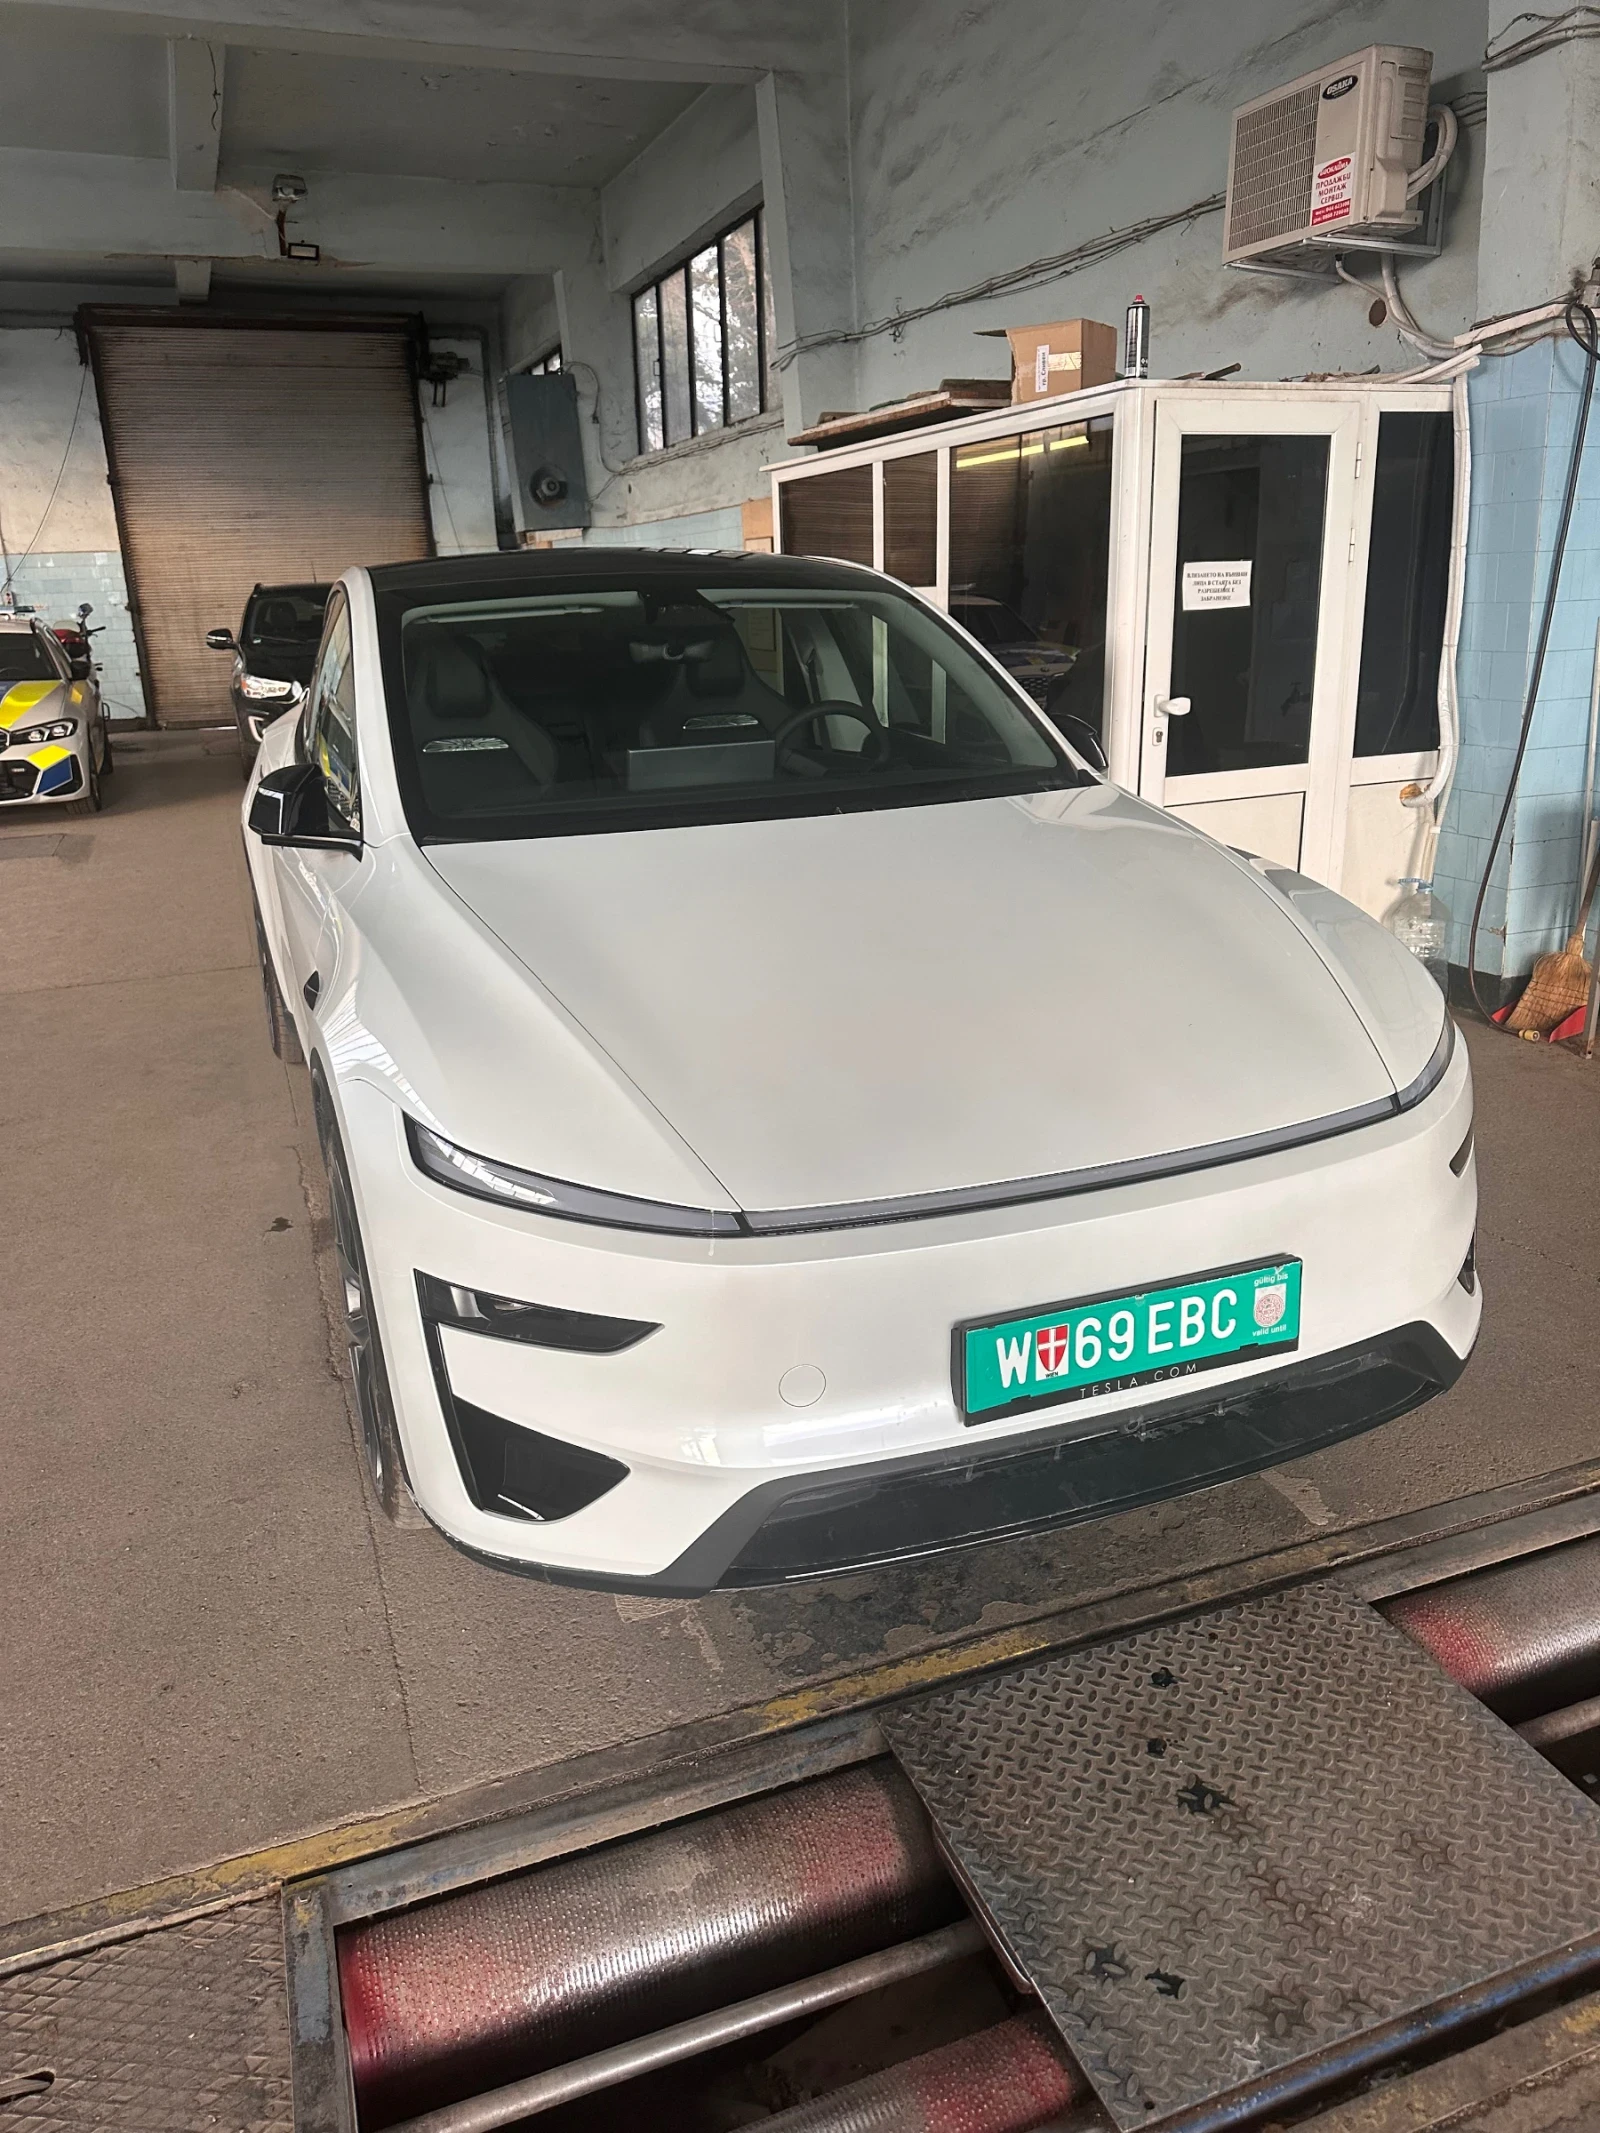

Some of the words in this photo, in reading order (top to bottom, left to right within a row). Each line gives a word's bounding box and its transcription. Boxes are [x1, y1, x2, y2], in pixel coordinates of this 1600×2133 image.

[1326, 76, 1353, 95] OSAKA
[1318, 182, 1347, 197] МОНТАЖ
[1277, 1272, 1289, 1282] bis
[995, 1331, 1033, 1389] W
[1074, 1309, 1136, 1369] 69
[1147, 1288, 1238, 1355] EBC
[1252, 1327, 1270, 1337] valid
[1270, 1323, 1287, 1334] until
[1079, 1362, 1197, 1399] TESLA.COM
